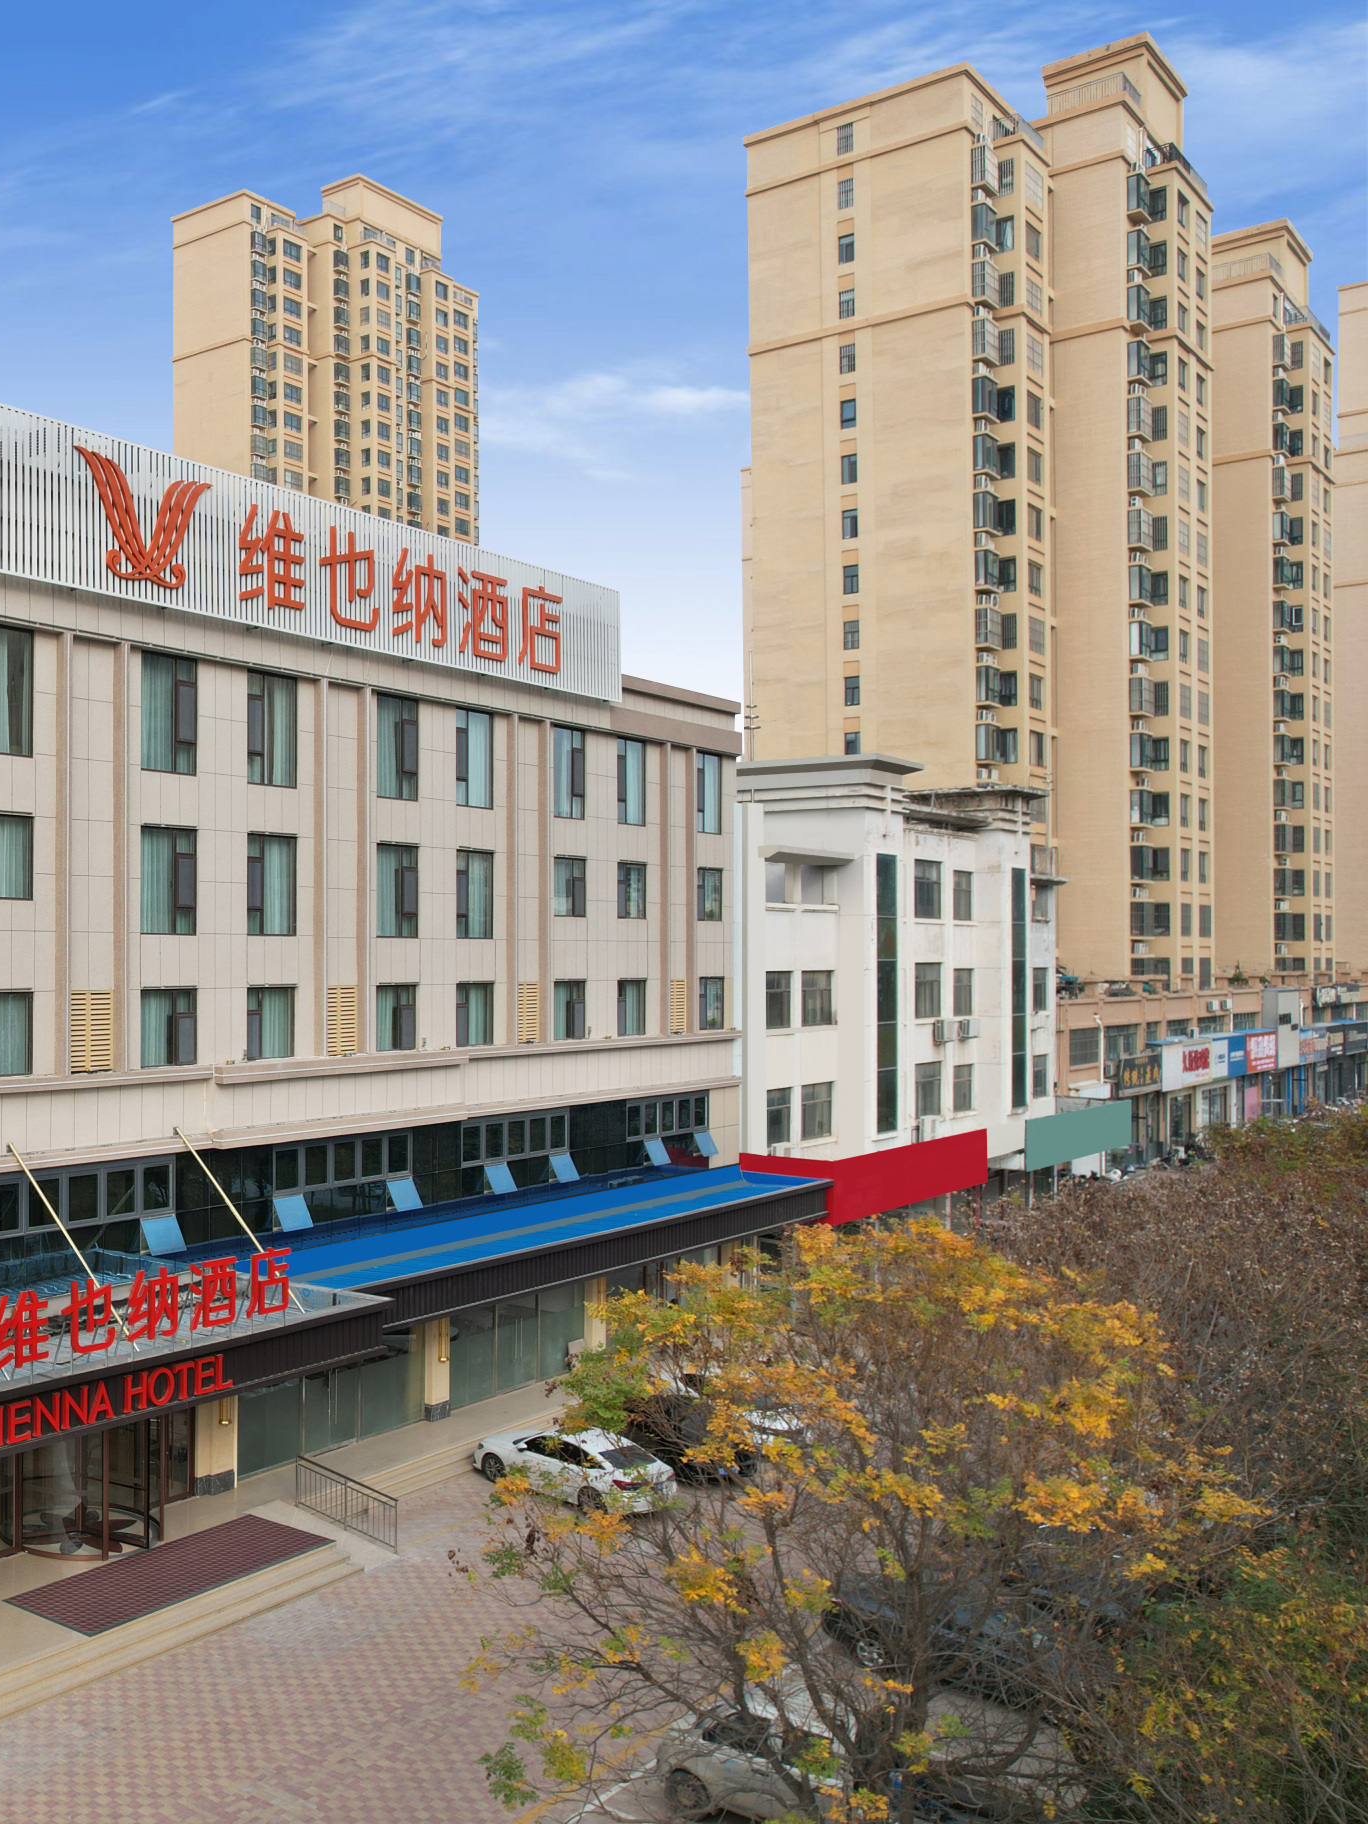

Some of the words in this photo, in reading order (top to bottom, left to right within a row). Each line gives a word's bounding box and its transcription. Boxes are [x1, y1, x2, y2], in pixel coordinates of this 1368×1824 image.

[238, 503, 562, 674] 维也纳酒店
[123, 1354, 234, 1414] HOTEL
